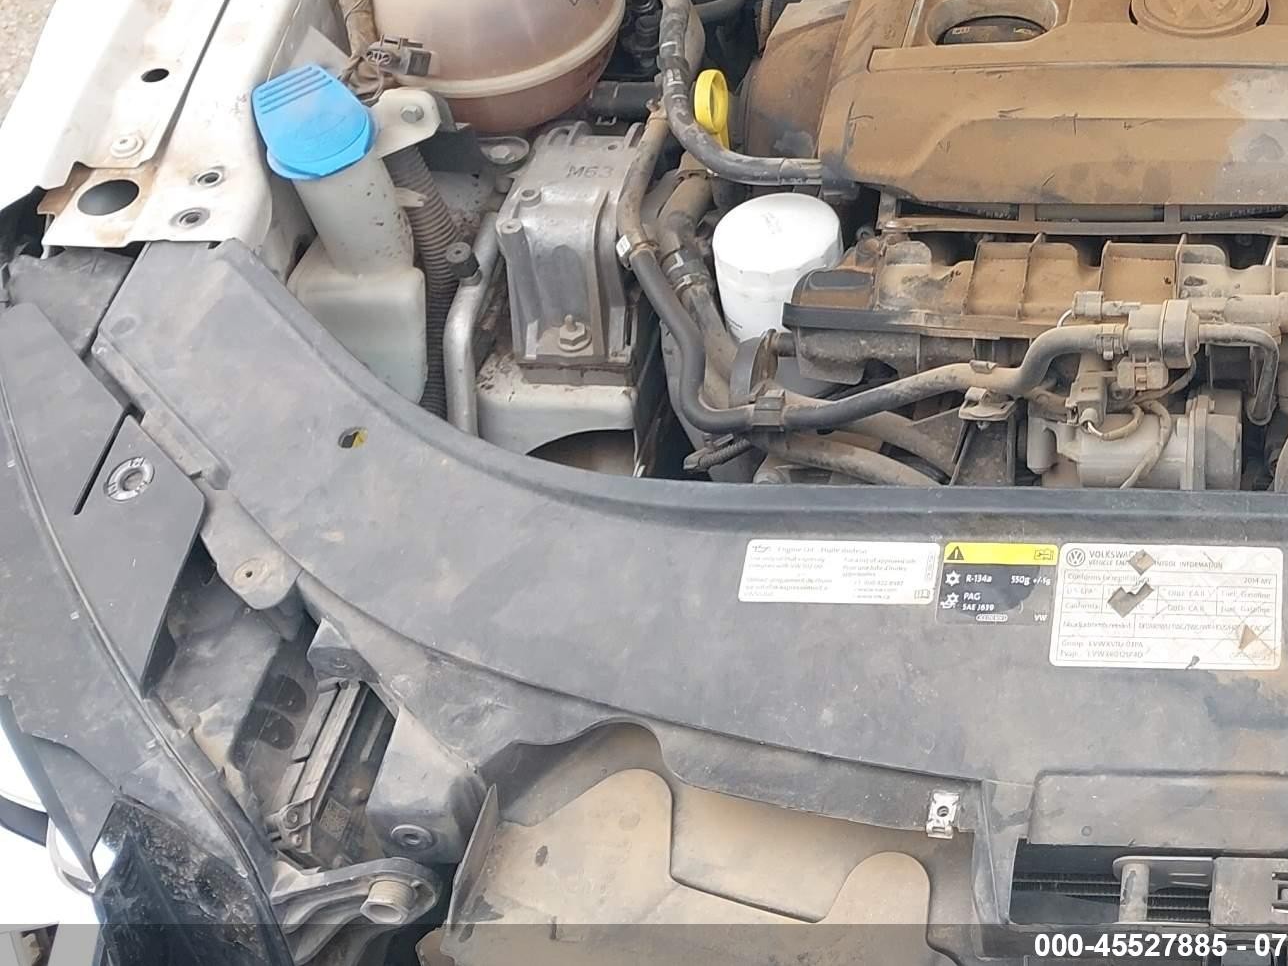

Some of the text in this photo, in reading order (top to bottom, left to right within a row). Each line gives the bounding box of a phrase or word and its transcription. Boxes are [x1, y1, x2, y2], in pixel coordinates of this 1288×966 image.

[566, 165, 615, 179] M63
[965, 574, 992, 583] R-134a
[1243, 577, 1259, 585] 2014
[963, 592, 981, 601] PAG
[962, 603, 976, 611] SAE
